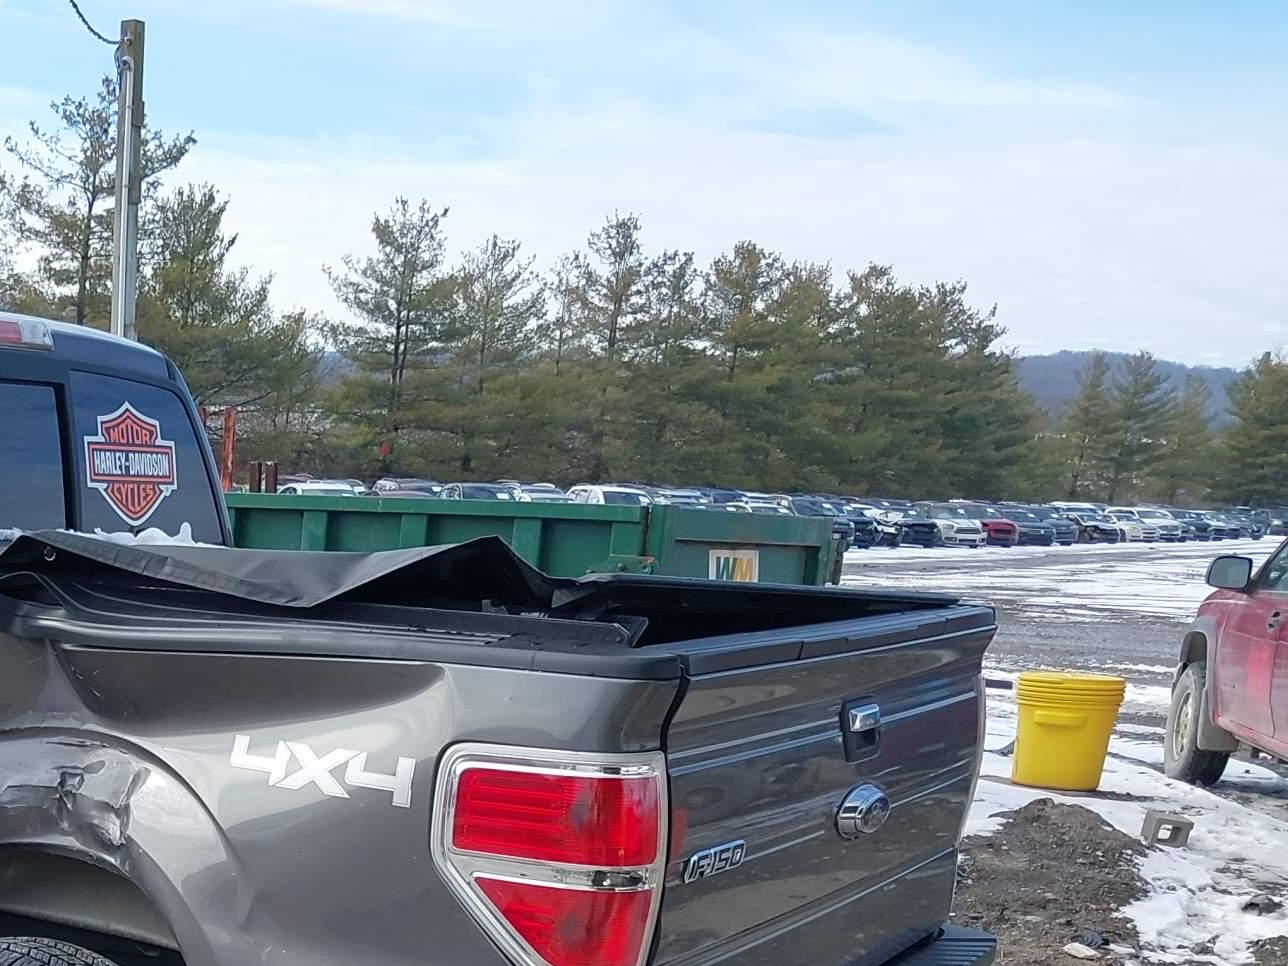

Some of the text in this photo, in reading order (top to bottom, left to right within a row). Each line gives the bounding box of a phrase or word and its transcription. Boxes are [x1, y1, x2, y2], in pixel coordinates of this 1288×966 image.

[110, 420, 150, 445] MOTOR
[93, 450, 170, 476] HARLEY-DAVIDSON
[113, 483, 154, 513] CYCLES
[715, 556, 754, 582] WM
